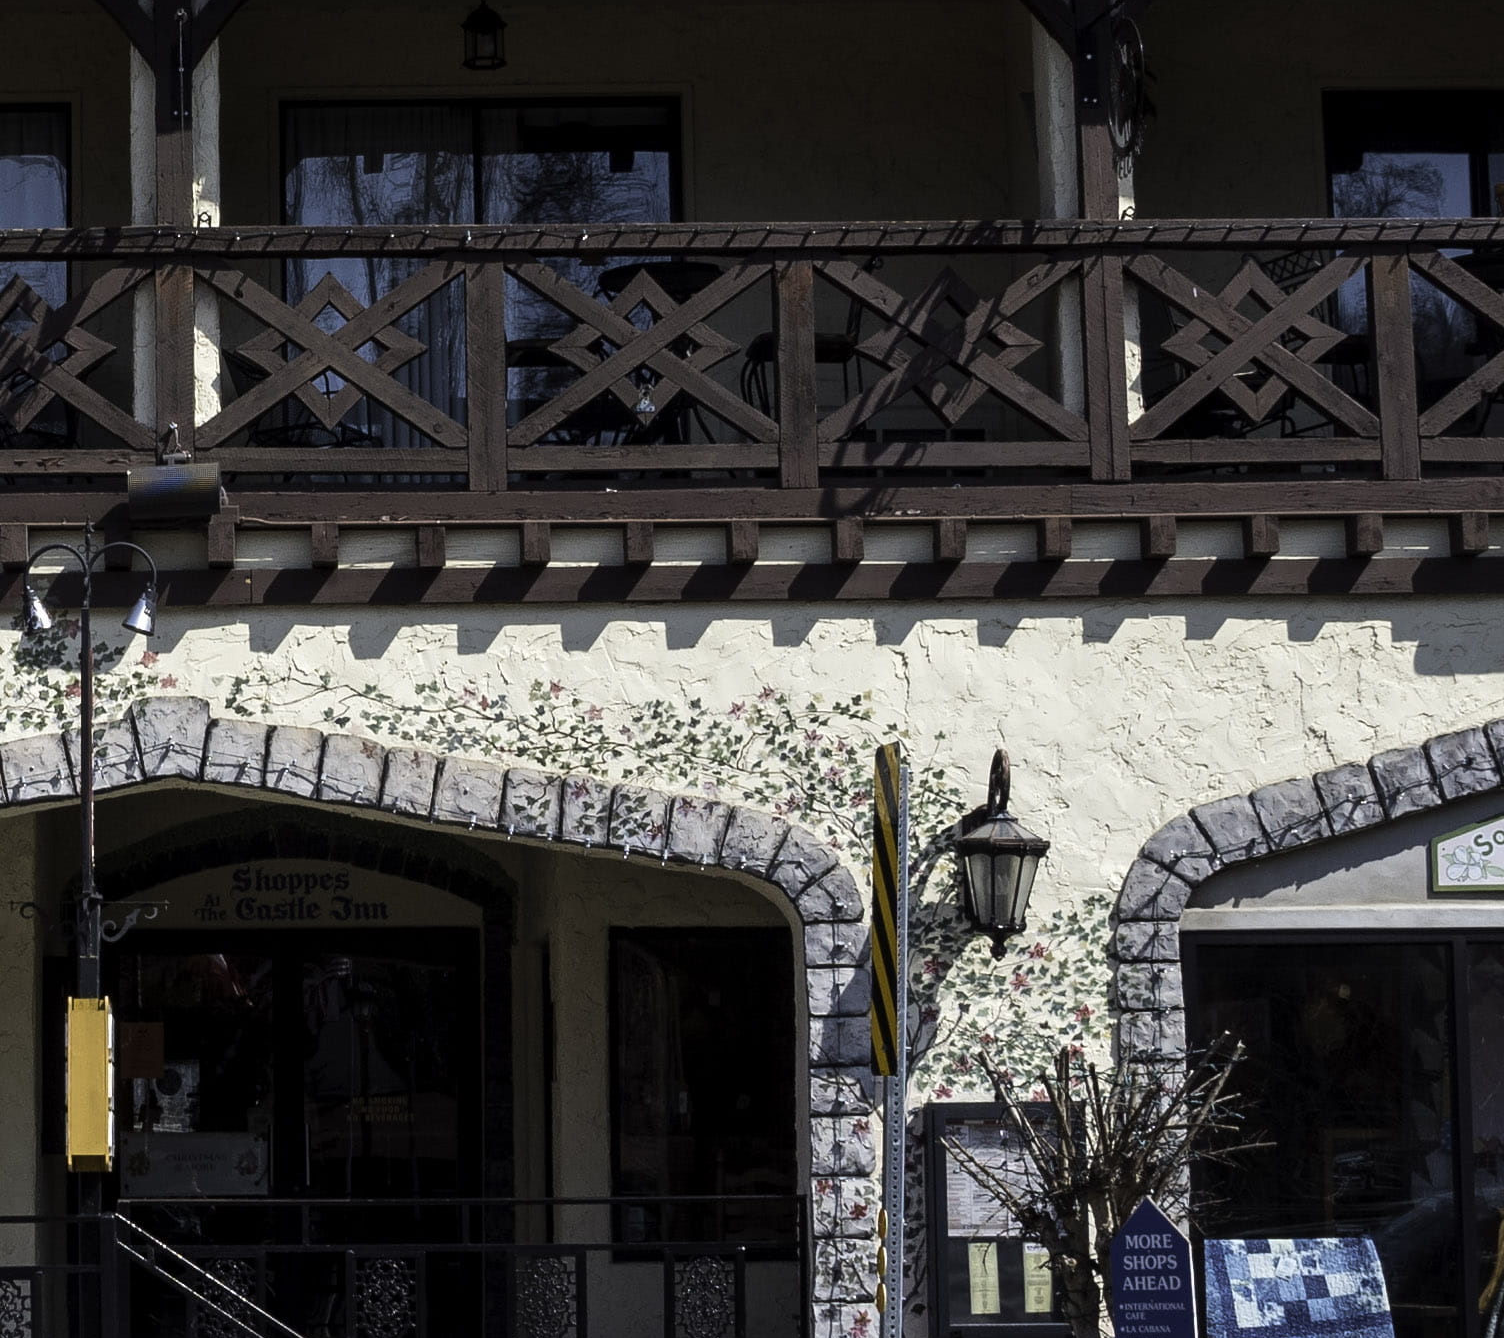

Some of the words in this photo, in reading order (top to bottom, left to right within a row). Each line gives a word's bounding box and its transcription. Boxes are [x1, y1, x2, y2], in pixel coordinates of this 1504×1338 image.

[232, 866, 350, 895] Shoppes
[234, 897, 320, 922] Castle
[330, 896, 391, 921] Inn
[1124, 1234, 1173, 1249] MORE
[1123, 1255, 1178, 1271] SHOPS
[1122, 1275, 1182, 1291] AHEAD
[1124, 1302, 1186, 1311] INTERNATIONAL
[1126, 1325, 1137, 1333] LA
[1138, 1325, 1172, 1333] CABANA
